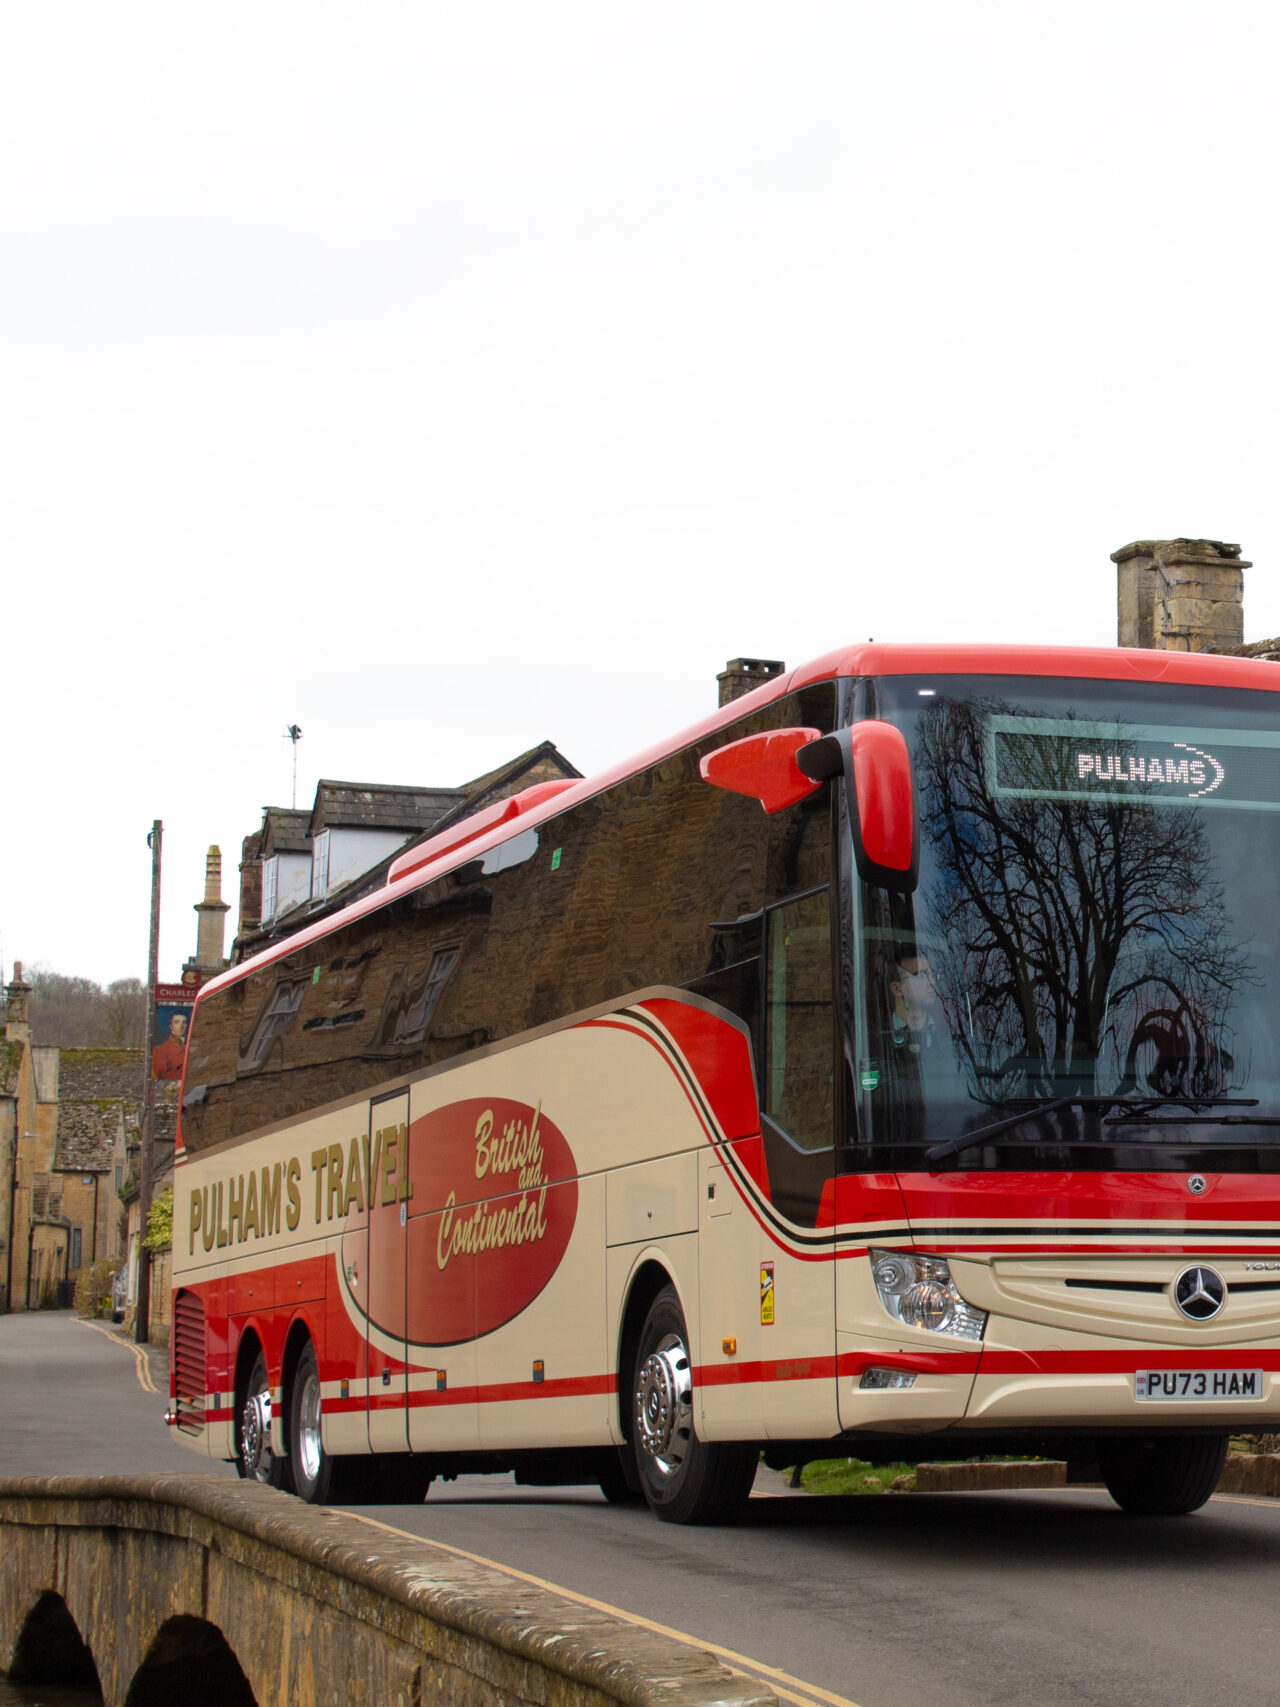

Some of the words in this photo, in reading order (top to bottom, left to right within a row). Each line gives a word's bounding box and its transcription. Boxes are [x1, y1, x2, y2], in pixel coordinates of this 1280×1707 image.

[1078, 754, 1206, 785] PULHAMS
[160, 988, 195, 997] CHARLES
[475, 1097, 542, 1180] British
[189, 1156, 301, 1256] PULHAM'S
[311, 1122, 413, 1224] TRAVEL
[518, 1148, 544, 1191] and
[436, 1174, 549, 1272] Continental
[1147, 1373, 1207, 1396] PU73
[1213, 1372, 1256, 1395] HAM
